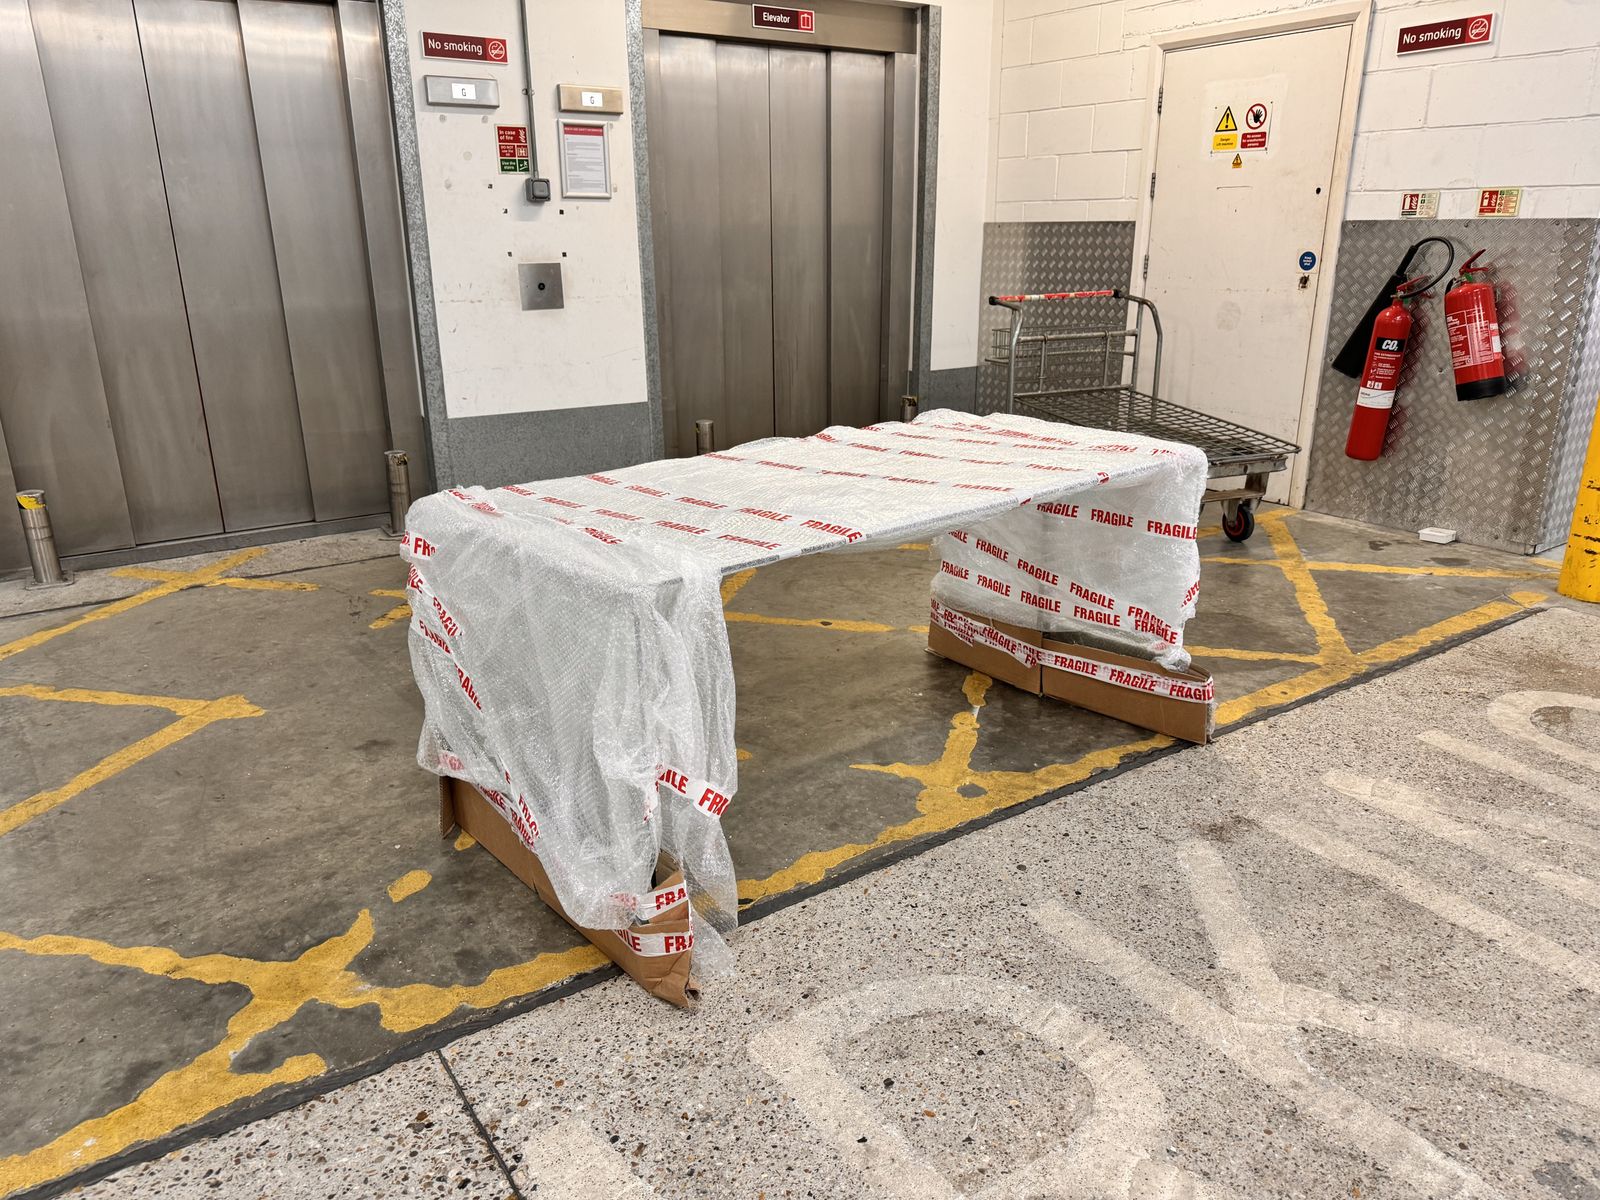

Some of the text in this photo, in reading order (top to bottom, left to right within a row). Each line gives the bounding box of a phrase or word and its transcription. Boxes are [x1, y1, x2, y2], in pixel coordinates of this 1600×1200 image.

[762, 12, 790, 24] Elevator
[1402, 27, 1462, 44] No smoking
[428, 39, 483, 56] No smoking
[461, 88, 467, 97] G
[734, 508, 792, 522] FRAGILE
[800, 520, 862, 543] FRAGILE
[1091, 509, 1134, 527] FRAGILE
[717, 534, 782, 550] FRAGILE
[976, 538, 1008, 562] FRAGILE
[1018, 559, 1059, 585] FRAGILE
[1070, 582, 1115, 610] FRAGILE
[941, 560, 1178, 644] FRAGILE FRAGILE FRAGILE FRAGILE FRAGILE
[982, 627, 1017, 655] FRAGILE
[1054, 656, 1098, 675] FRAGILE
[1109, 669, 1158, 691] FRAGILE
